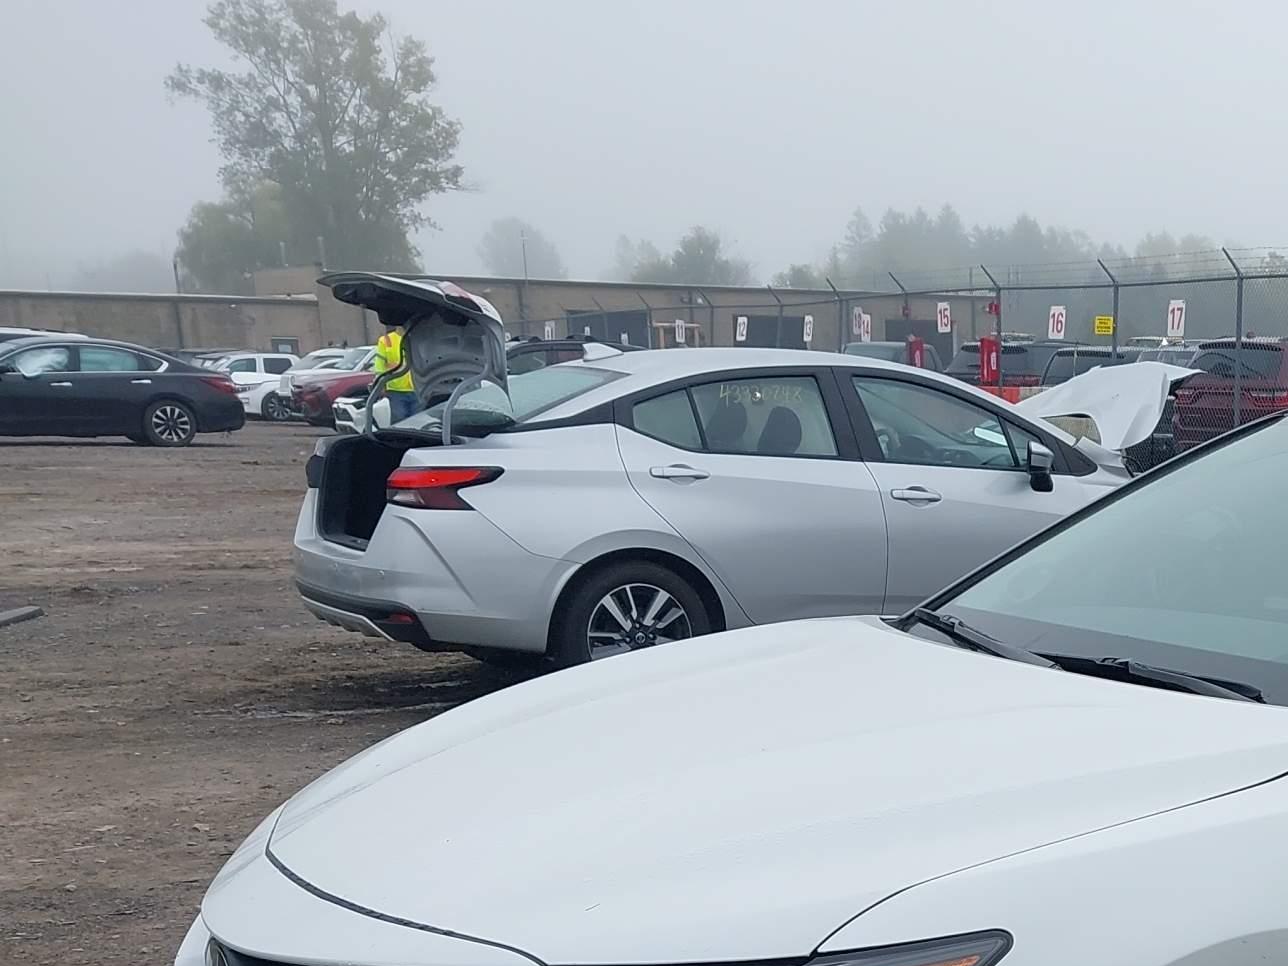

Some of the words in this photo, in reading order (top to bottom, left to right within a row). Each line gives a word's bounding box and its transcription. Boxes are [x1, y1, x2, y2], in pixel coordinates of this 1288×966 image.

[938, 308, 949, 328] 15
[1050, 311, 1064, 334] 16
[1169, 307, 1184, 331] 17
[676, 324, 685, 339] 11
[737, 321, 746, 337] 12
[805, 320, 813, 337] 13
[862, 320, 870, 336] 14
